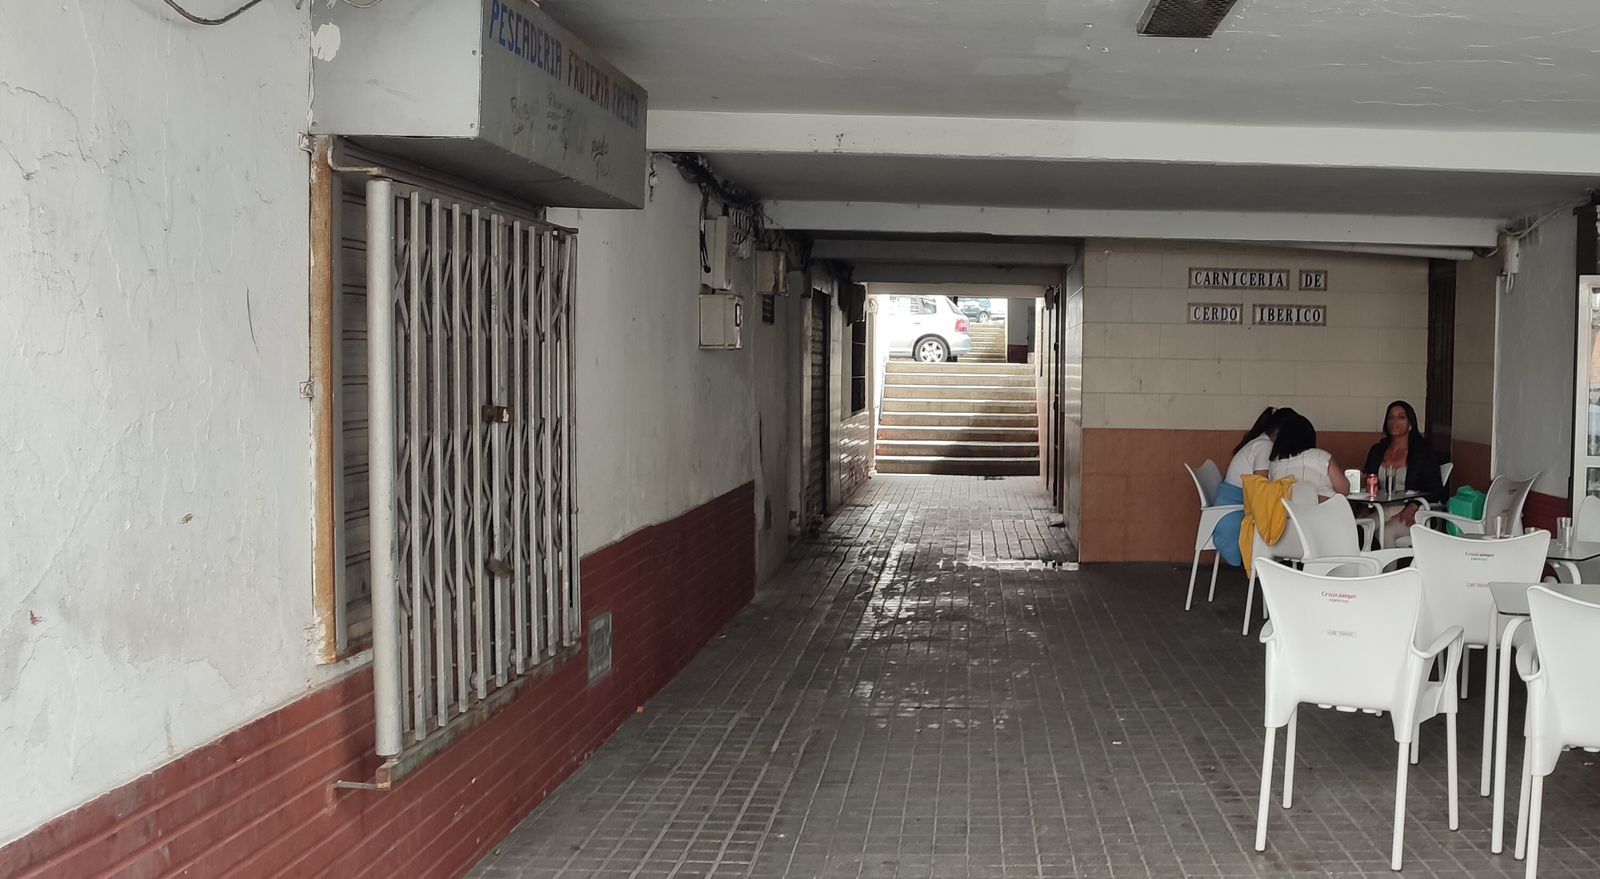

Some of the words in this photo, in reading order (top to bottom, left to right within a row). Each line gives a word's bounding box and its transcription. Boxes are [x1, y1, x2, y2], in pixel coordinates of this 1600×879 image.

[489, 0, 562, 80] PESCADERIA
[567, 49, 609, 111] FRUTERIA
[1194, 271, 1284, 287] CARNICERIA
[1304, 273, 1322, 288] DE
[1193, 306, 1238, 321] CERDO
[1259, 307, 1321, 322] IBERICO
